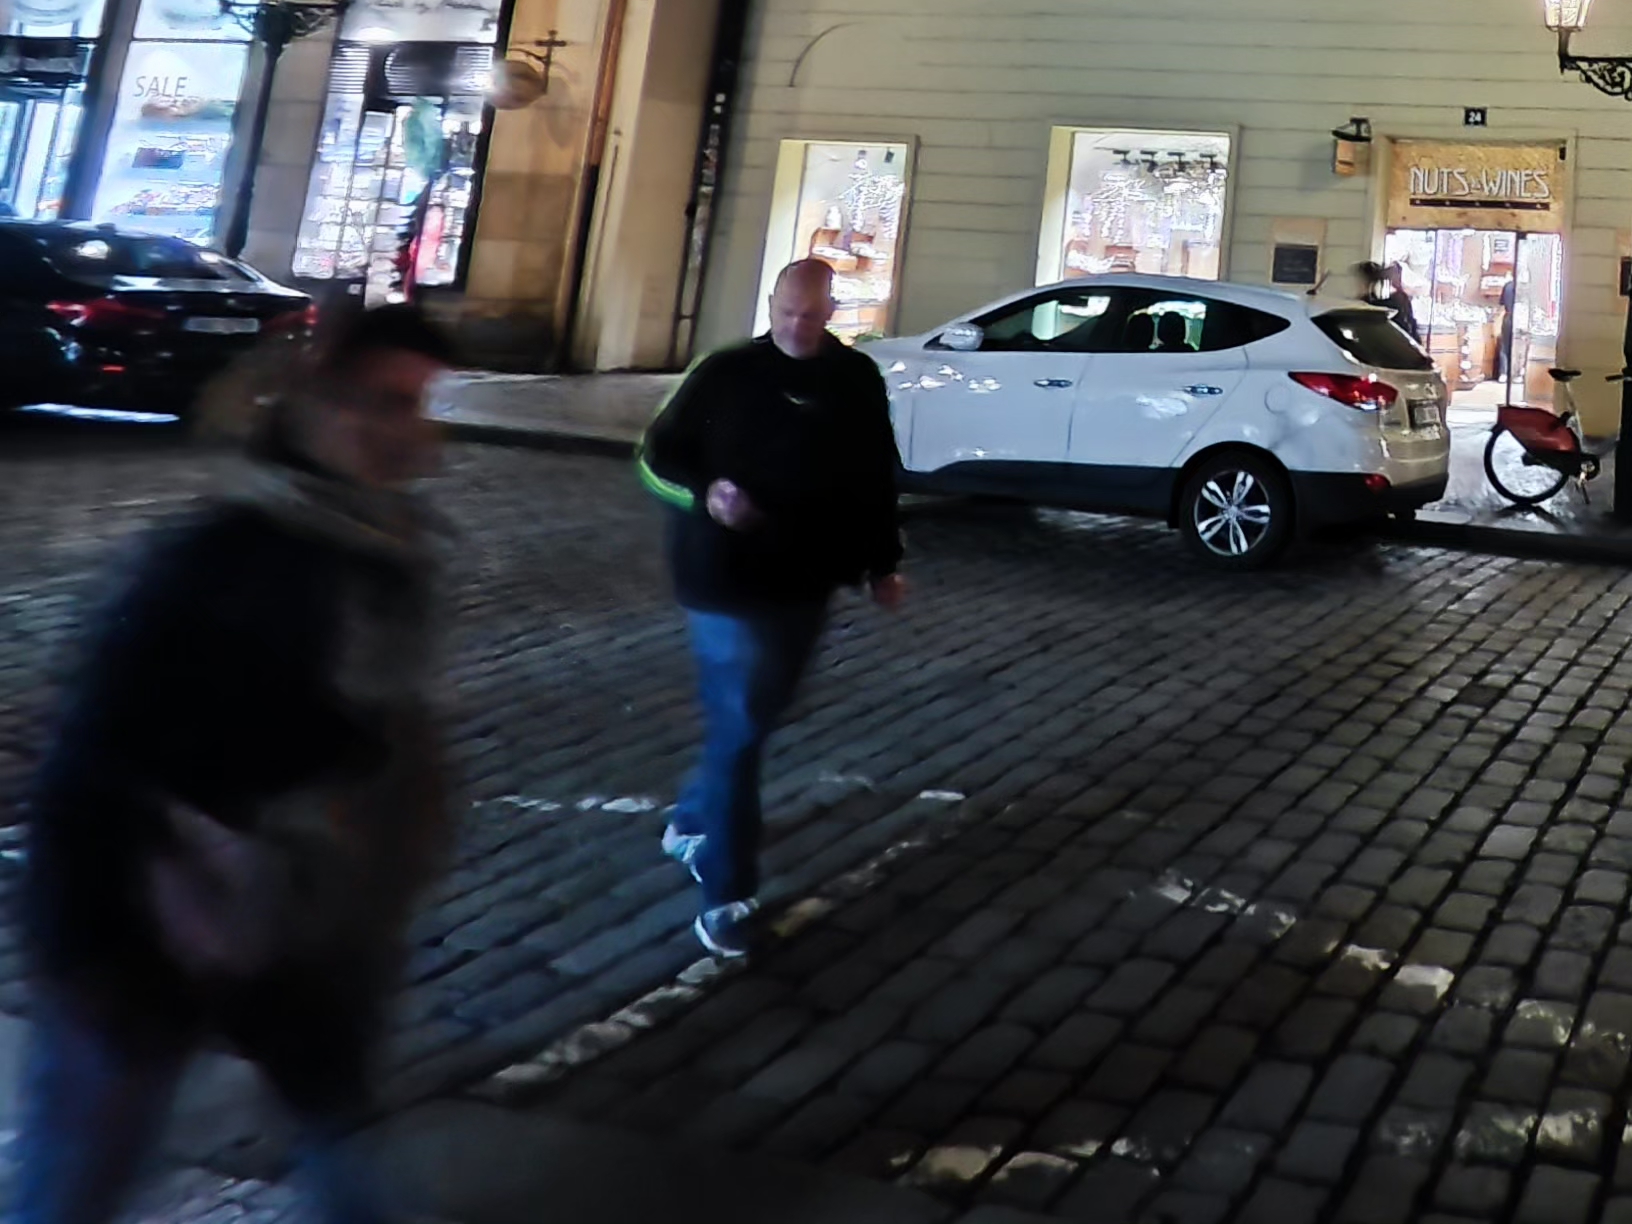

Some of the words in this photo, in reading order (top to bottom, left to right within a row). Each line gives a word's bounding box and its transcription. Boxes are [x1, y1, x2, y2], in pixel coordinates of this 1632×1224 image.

[134, 76, 188, 97] SALE
[1468, 111, 1482, 123] 24
[1410, 166, 1470, 196] NUTS
[1482, 167, 1550, 198] WINES
